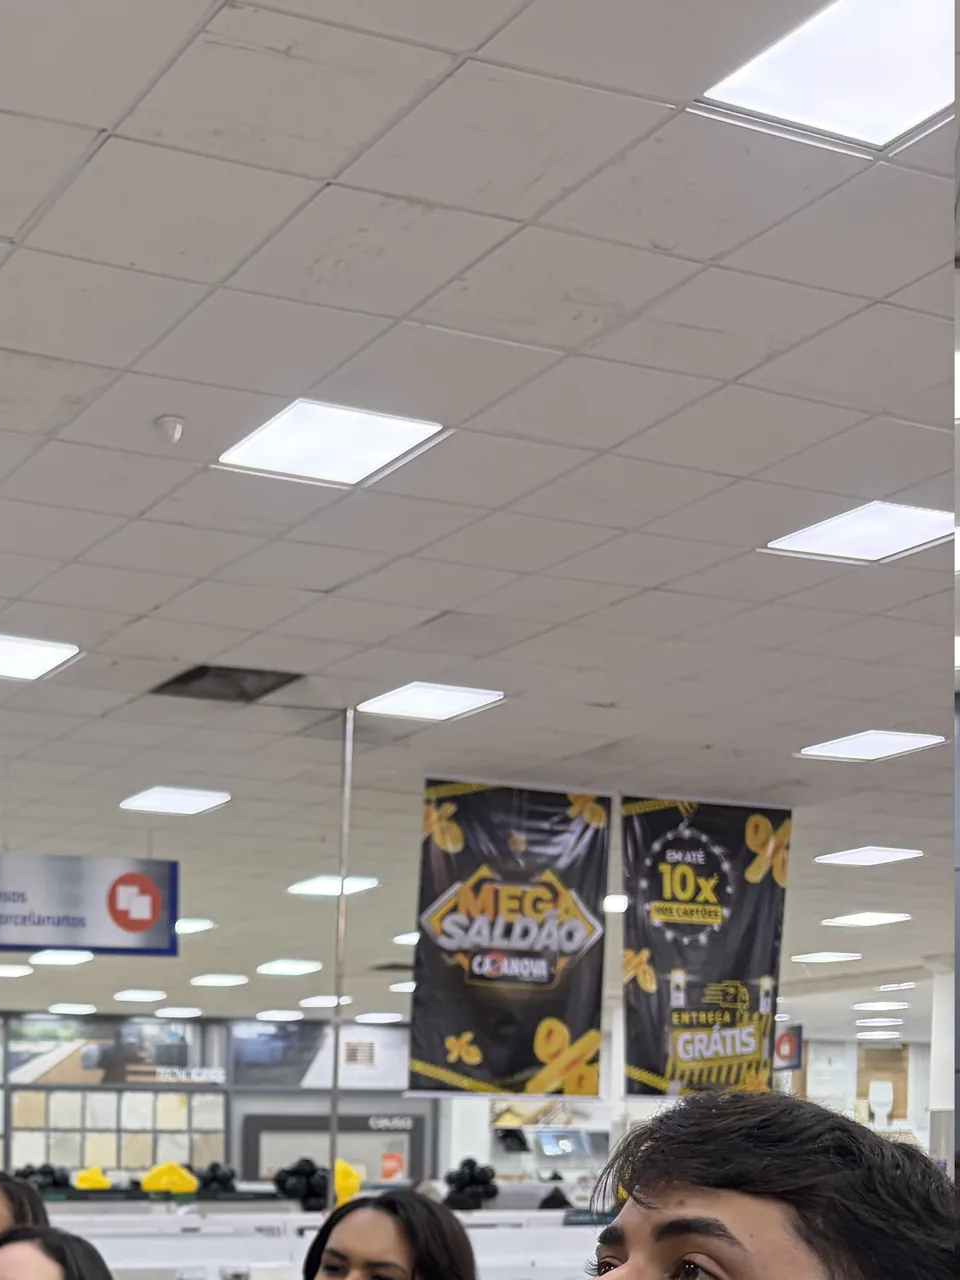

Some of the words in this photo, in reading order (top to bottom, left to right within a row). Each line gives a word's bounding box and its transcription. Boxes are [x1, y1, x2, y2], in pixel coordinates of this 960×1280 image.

[658, 862, 719, 904] 10x
[438, 909, 587, 953] SALDÃO
[671, 1010, 731, 1025] ENTREGA
[677, 1023, 756, 1061] GRÁTIS
